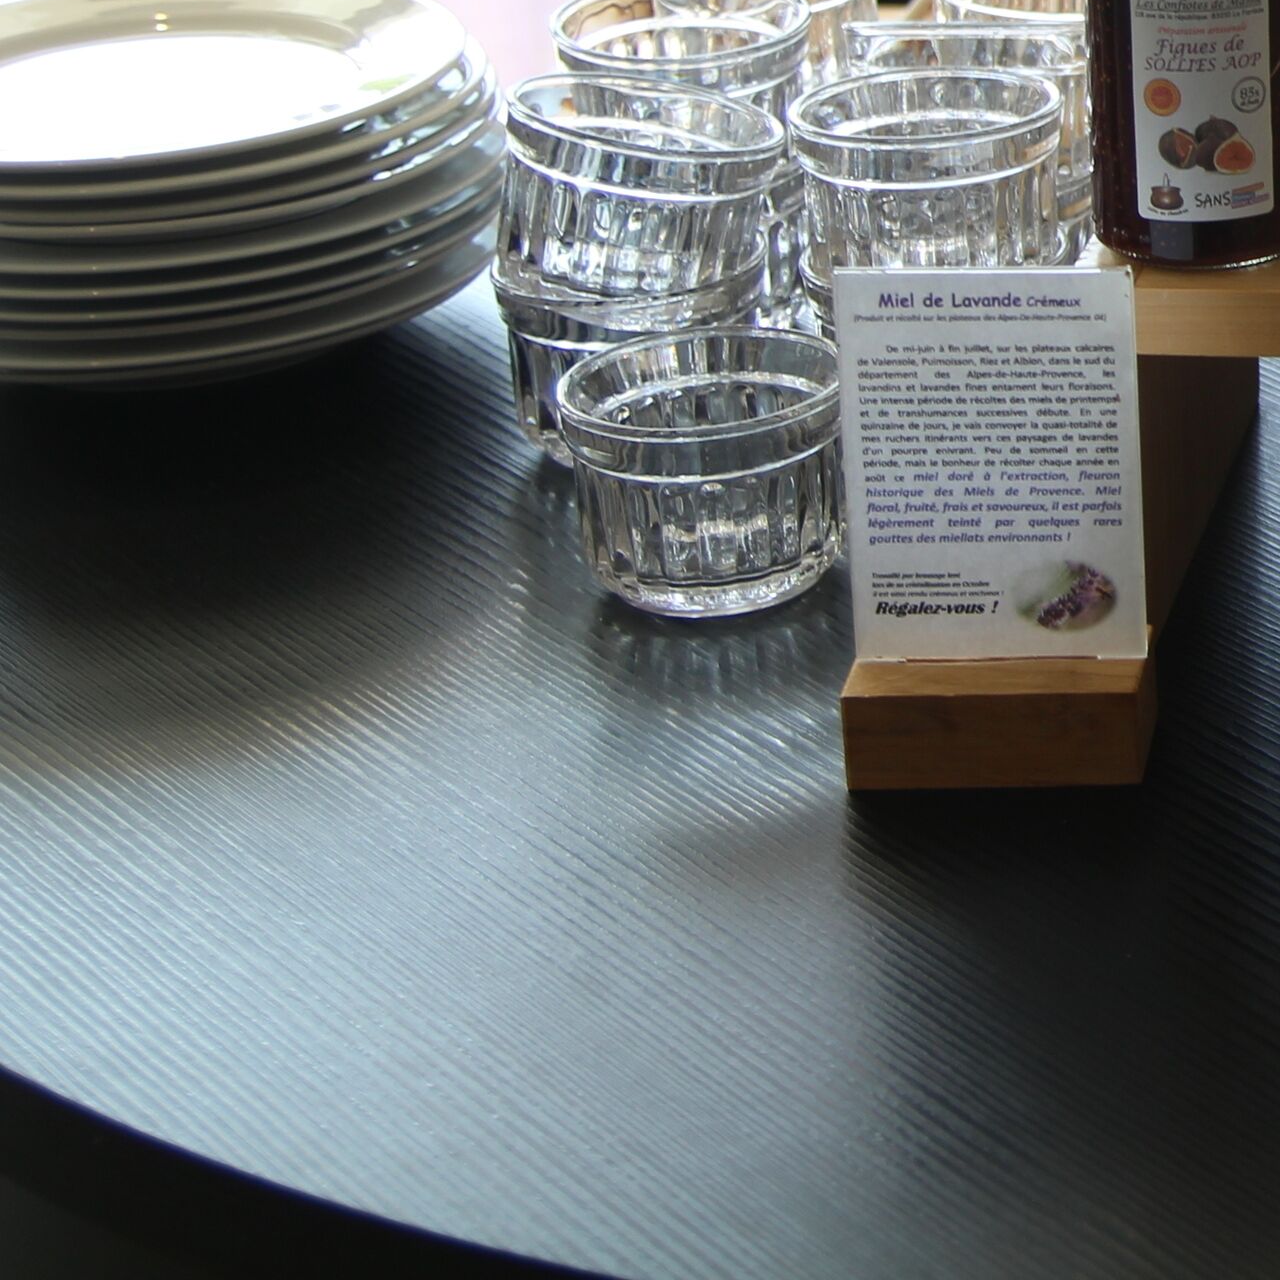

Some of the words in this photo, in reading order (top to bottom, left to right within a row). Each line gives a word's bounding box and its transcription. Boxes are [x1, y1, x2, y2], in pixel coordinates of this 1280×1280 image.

[1154, 38, 1217, 60] Figues
[1223, 33, 1245, 53] de
[1222, 52, 1262, 71] AOP
[1194, 191, 1232, 208] SANS
[878, 292, 914, 308] Miel
[922, 292, 943, 308] de
[951, 292, 1021, 308] Lavande
[1026, 295, 1080, 308] Crémeux
[864, 473, 887, 482] août
[893, 473, 905, 482] ce
[912, 471, 939, 482] miel
[946, 471, 974, 481] doré
[982, 471, 992, 481] à
[999, 470, 1070, 481] l'extraction,
[1077, 469, 1121, 482] fleuron
[866, 487, 923, 498] historique
[934, 486, 953, 497] des
[964, 486, 993, 496] Miels
[1005, 486, 1018, 496] de
[1029, 486, 1083, 496] Provence.
[1096, 485, 1121, 495] Miel
[866, 502, 901, 514] floral,
[903, 501, 939, 514] fruité,
[942, 501, 968, 513] frais
[971, 502, 983, 512] et
[985, 503, 1048, 512] savoureux,
[1051, 500, 1060, 511] il
[1061, 502, 1079, 511] est
[1081, 500, 1122, 513] parfois
[868, 517, 934, 529] légèrement
[947, 517, 981, 527] teinté
[995, 519, 1015, 529] par
[1028, 517, 1079, 528] quelques
[1093, 518, 1122, 526] rares
[869, 534, 913, 545] gouttes
[916, 533, 936, 543] des
[939, 532, 984, 543] miellats
[988, 533, 1063, 543] environnants
[876, 600, 984, 617] Régalez-vous
